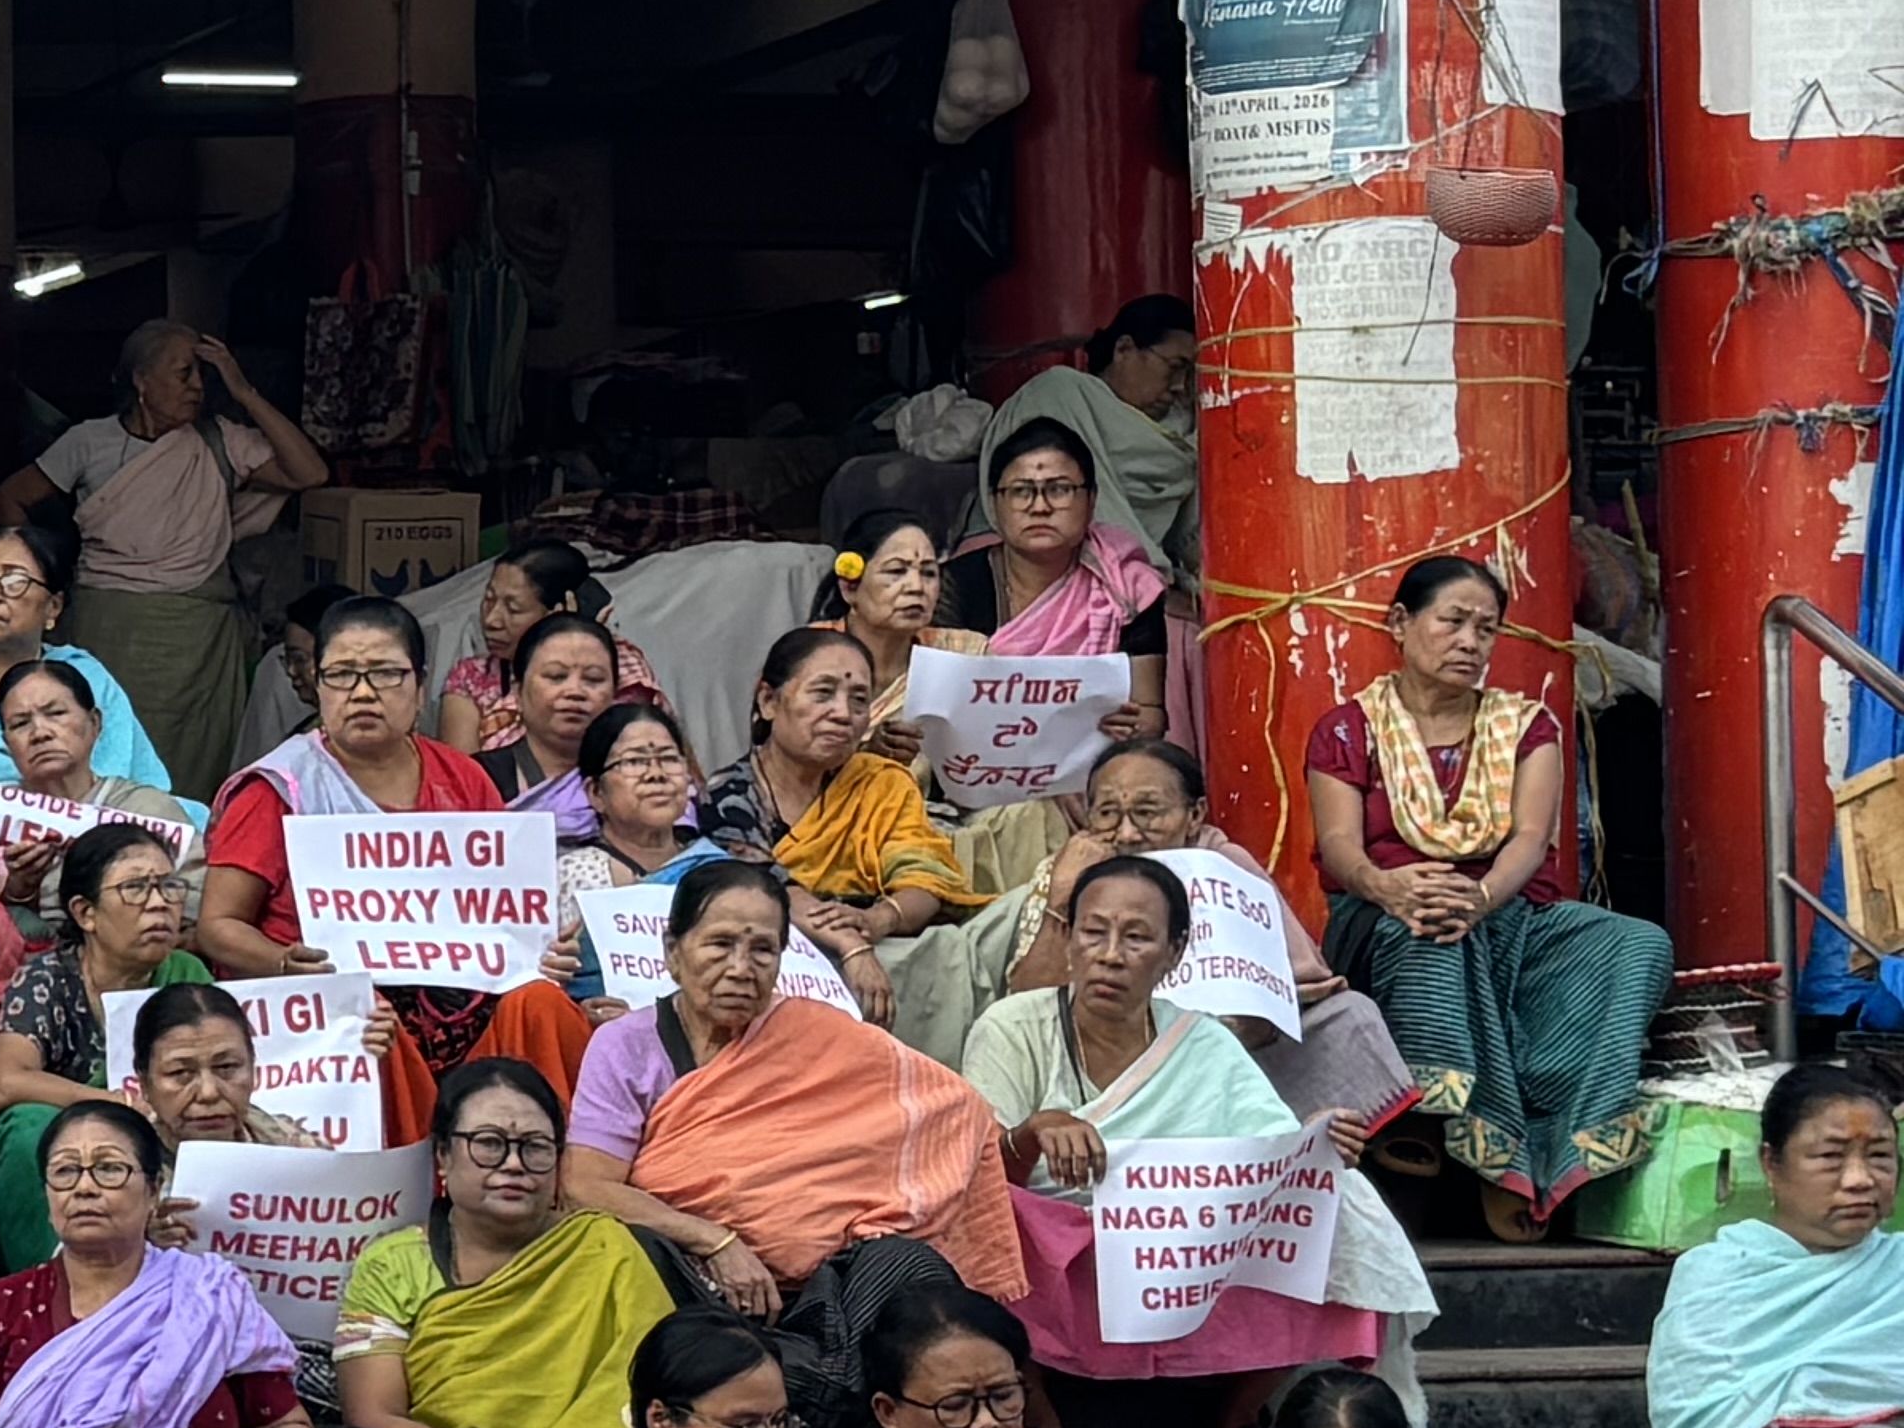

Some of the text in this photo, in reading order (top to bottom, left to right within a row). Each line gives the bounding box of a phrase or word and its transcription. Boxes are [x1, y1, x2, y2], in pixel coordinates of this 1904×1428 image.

[345, 829, 505, 869] INDIA GI
[306, 888, 550, 925] PROXY WAR
[356, 940, 507, 977] LEPPU
[609, 953, 667, 980] PEOP
[283, 992, 326, 1034] GI
[228, 1189, 402, 1224] SUNULOK
[1101, 1205, 1189, 1230] NAGA
[1198, 1204, 1216, 1229] 6
